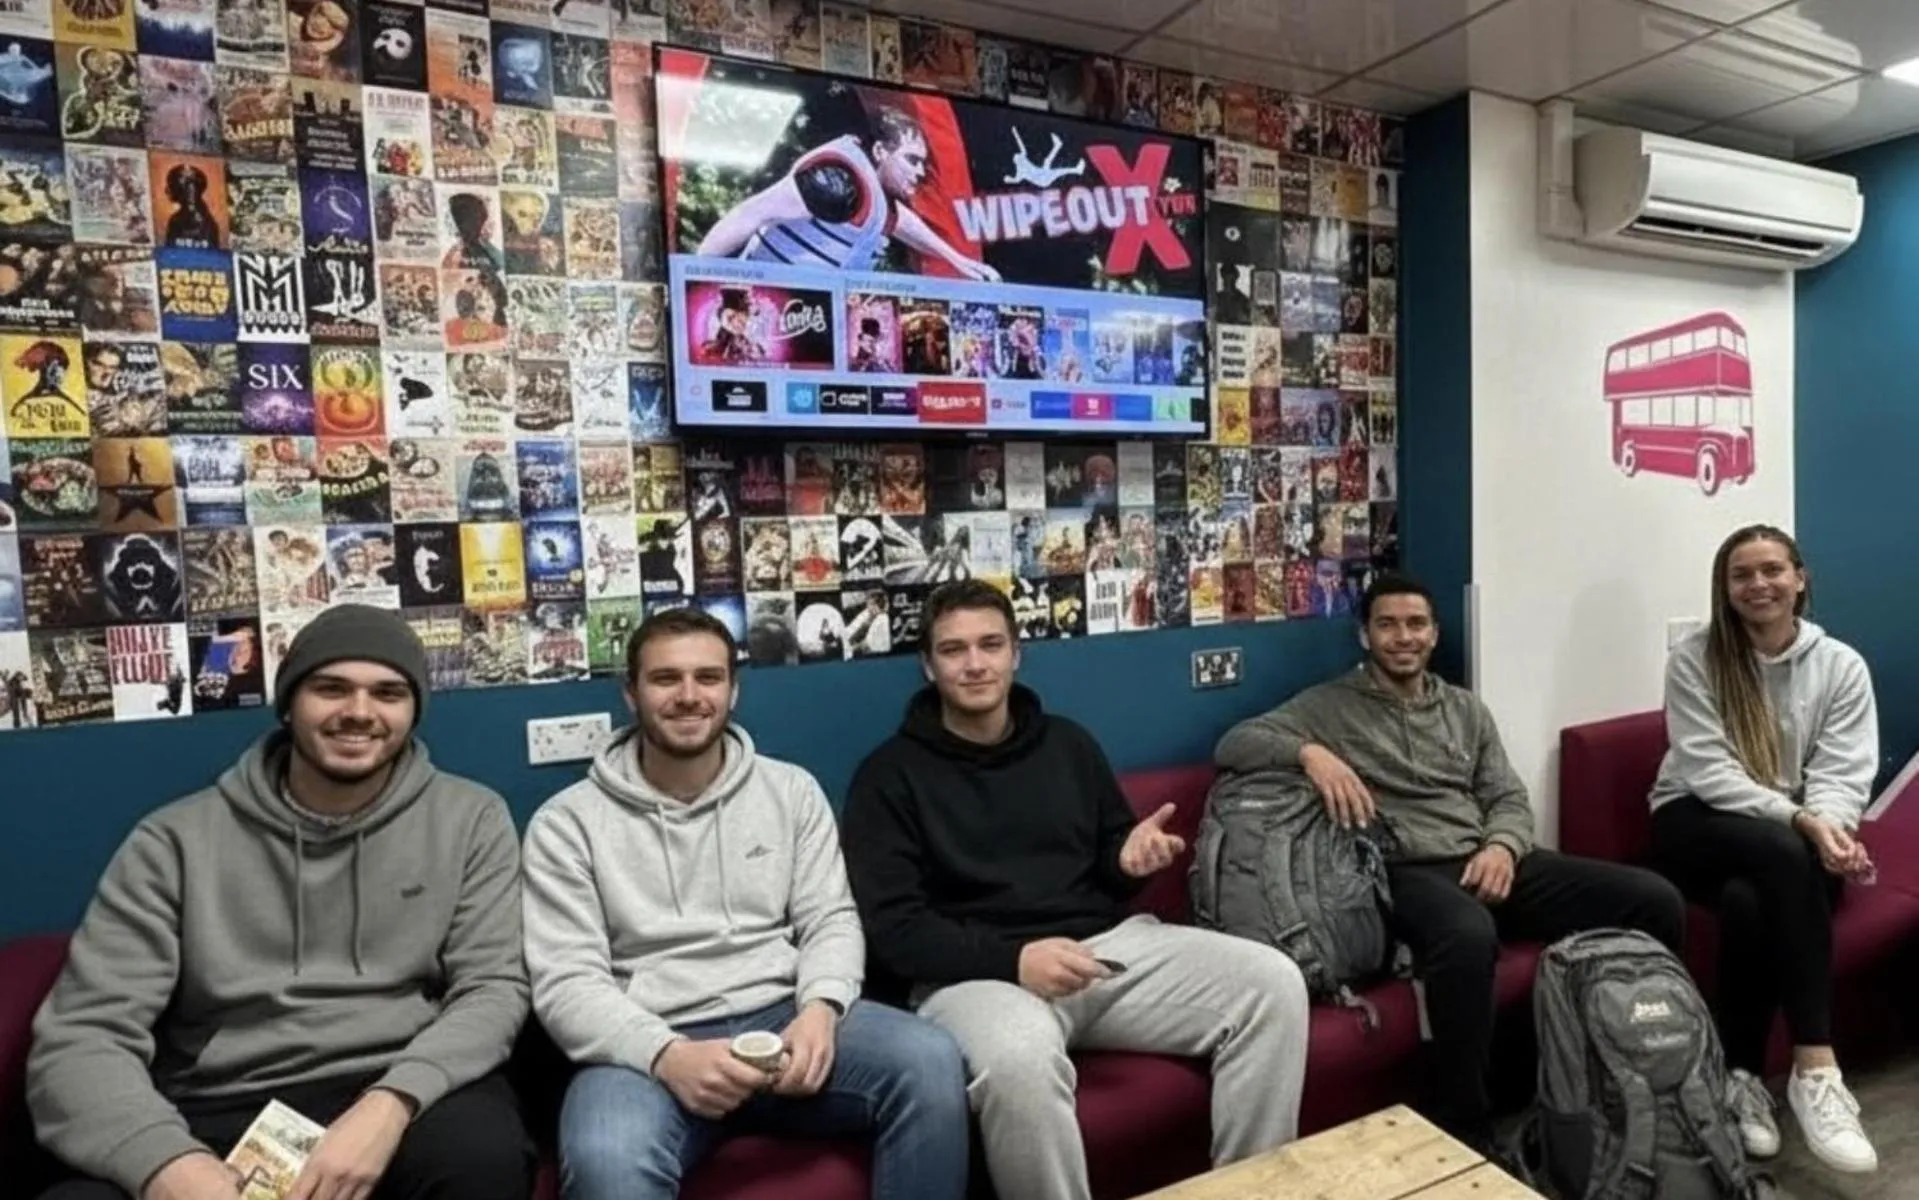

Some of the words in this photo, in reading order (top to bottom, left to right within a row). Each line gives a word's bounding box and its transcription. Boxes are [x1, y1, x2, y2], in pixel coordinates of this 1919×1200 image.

[953, 185, 1150, 242] WIPEOUT
[1085, 143, 1192, 274] X
[247, 363, 303, 390] SIX
